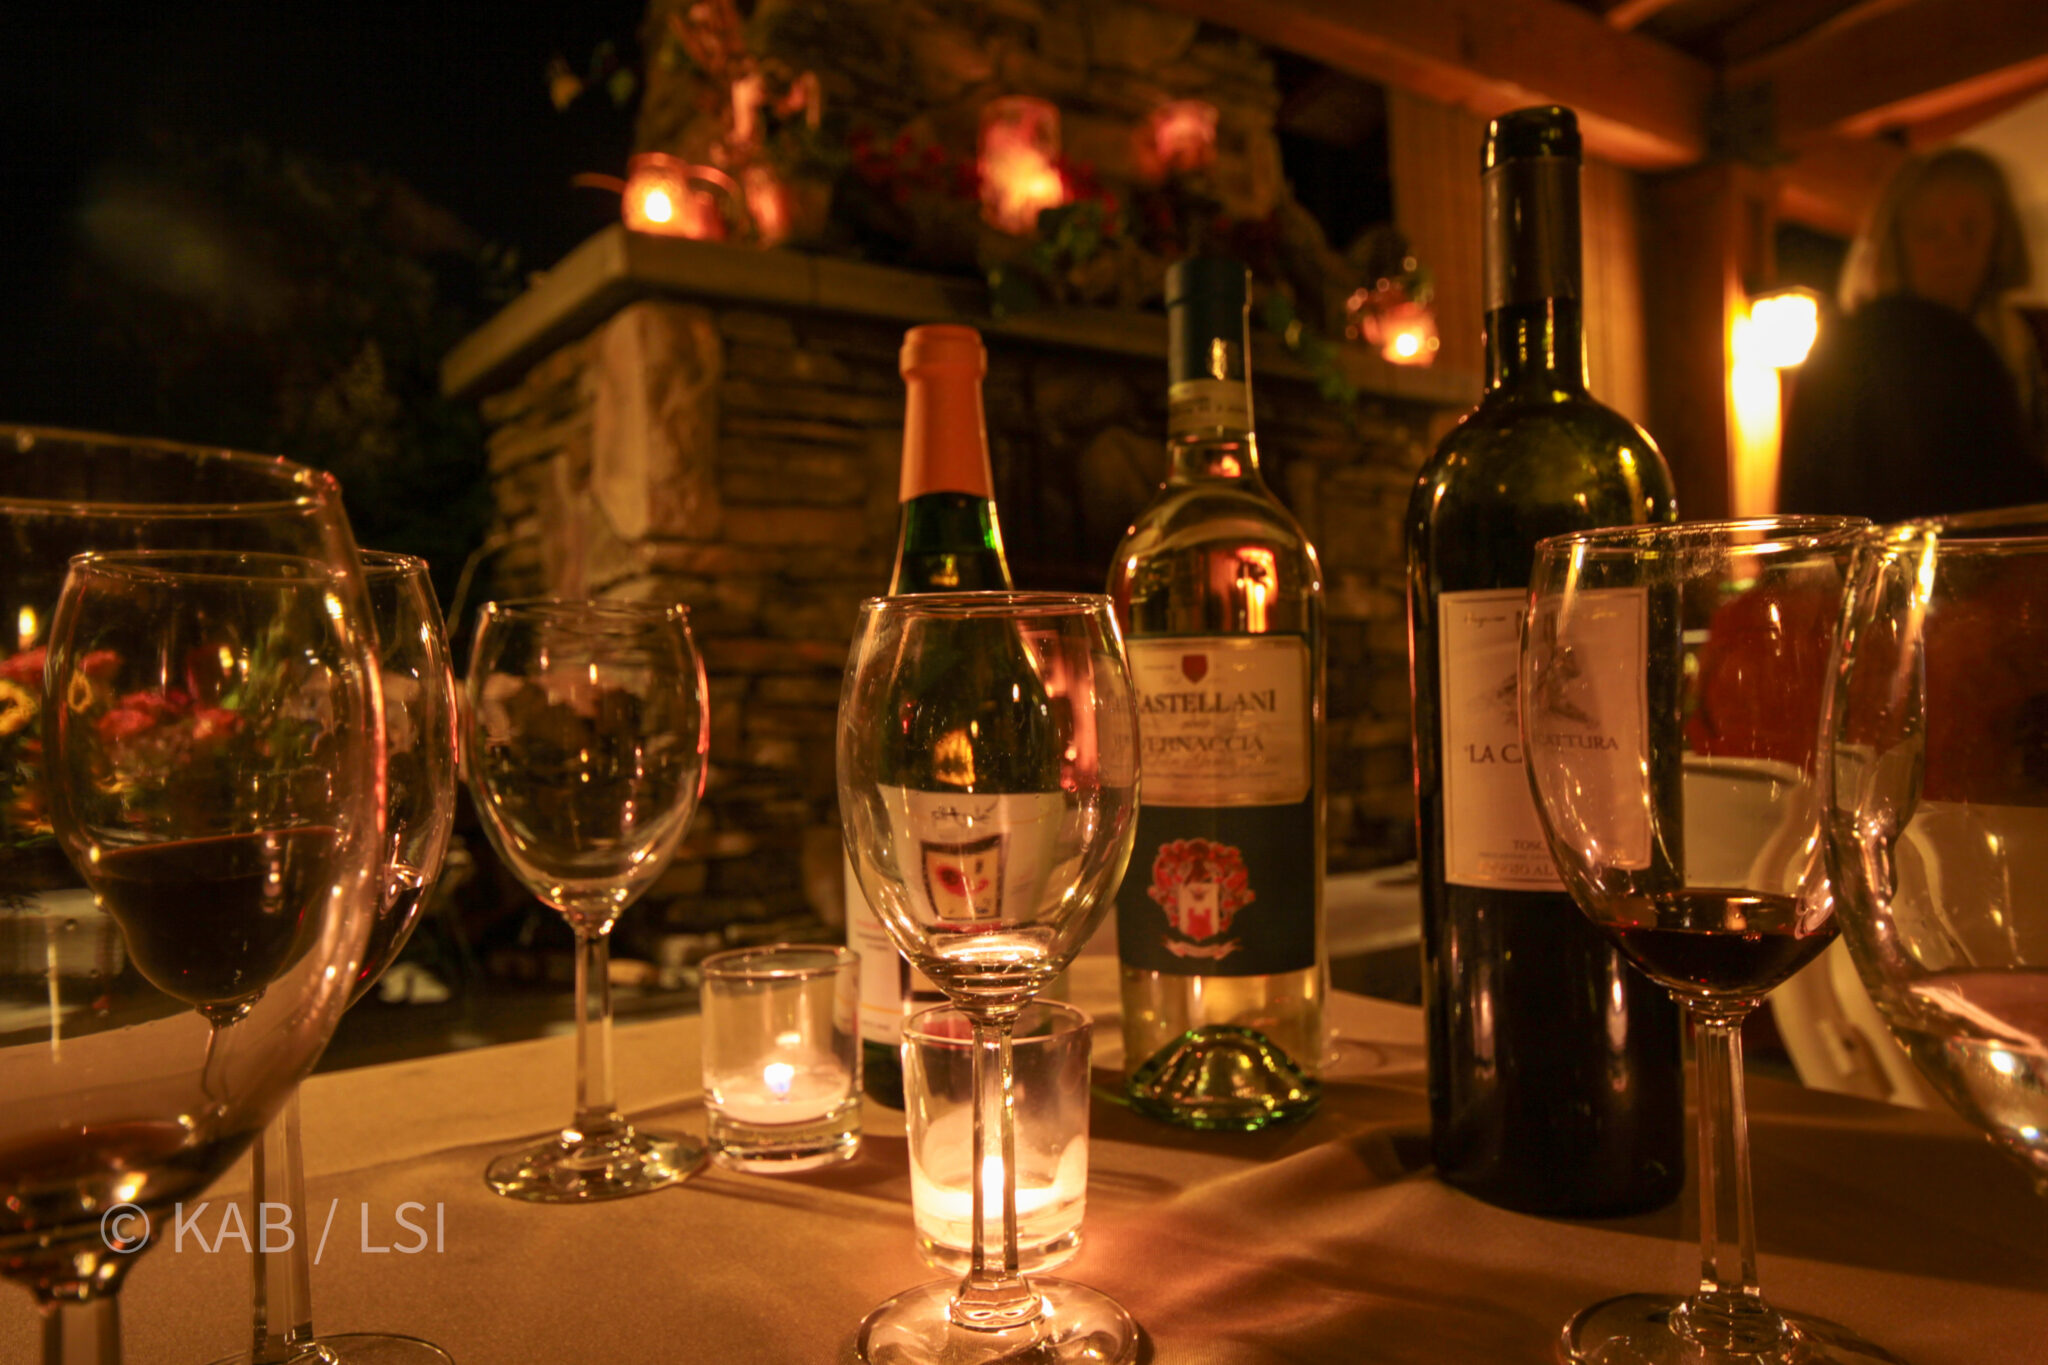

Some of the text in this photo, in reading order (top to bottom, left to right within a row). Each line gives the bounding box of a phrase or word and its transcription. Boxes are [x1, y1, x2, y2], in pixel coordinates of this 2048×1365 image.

[1136, 688, 1277, 714] ASTELLANI
[1140, 734, 1265, 754] ERNACCIA
[1469, 743, 1495, 764] LA
